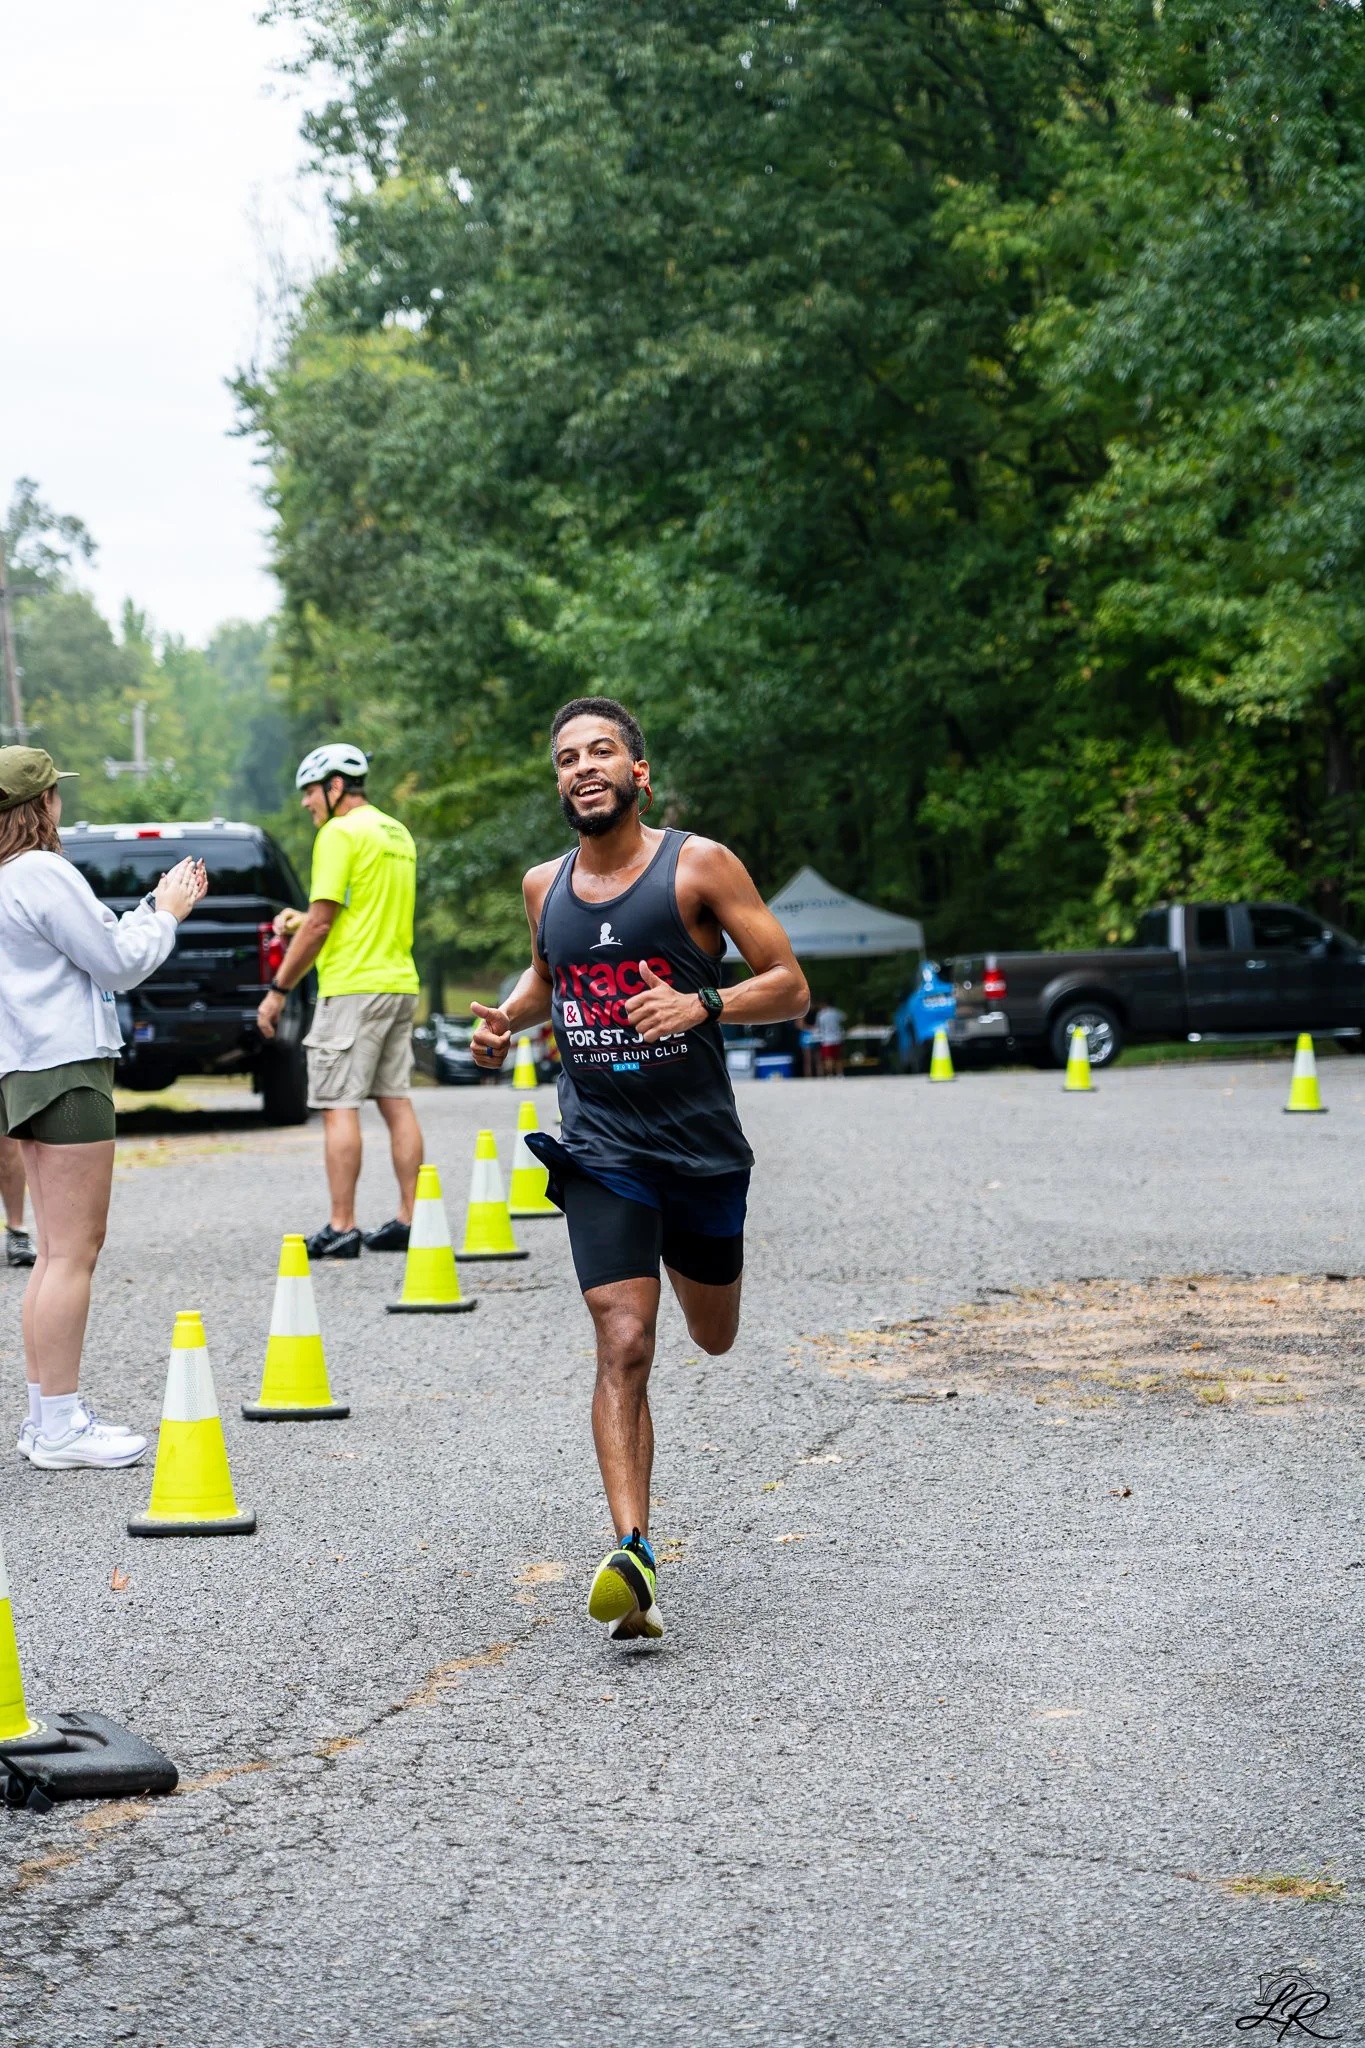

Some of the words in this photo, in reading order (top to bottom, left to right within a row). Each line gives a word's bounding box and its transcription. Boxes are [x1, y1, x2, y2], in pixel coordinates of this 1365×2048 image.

[568, 957, 673, 998] race
[565, 1004, 579, 1025] &
[566, 1030, 598, 1047] FOR
[600, 1029, 629, 1045] ST.
[573, 1053, 587, 1064] ST.
[589, 1052, 618, 1063] JUDE
[623, 1050, 650, 1061] RUN
[655, 1044, 688, 1058] CLUB
